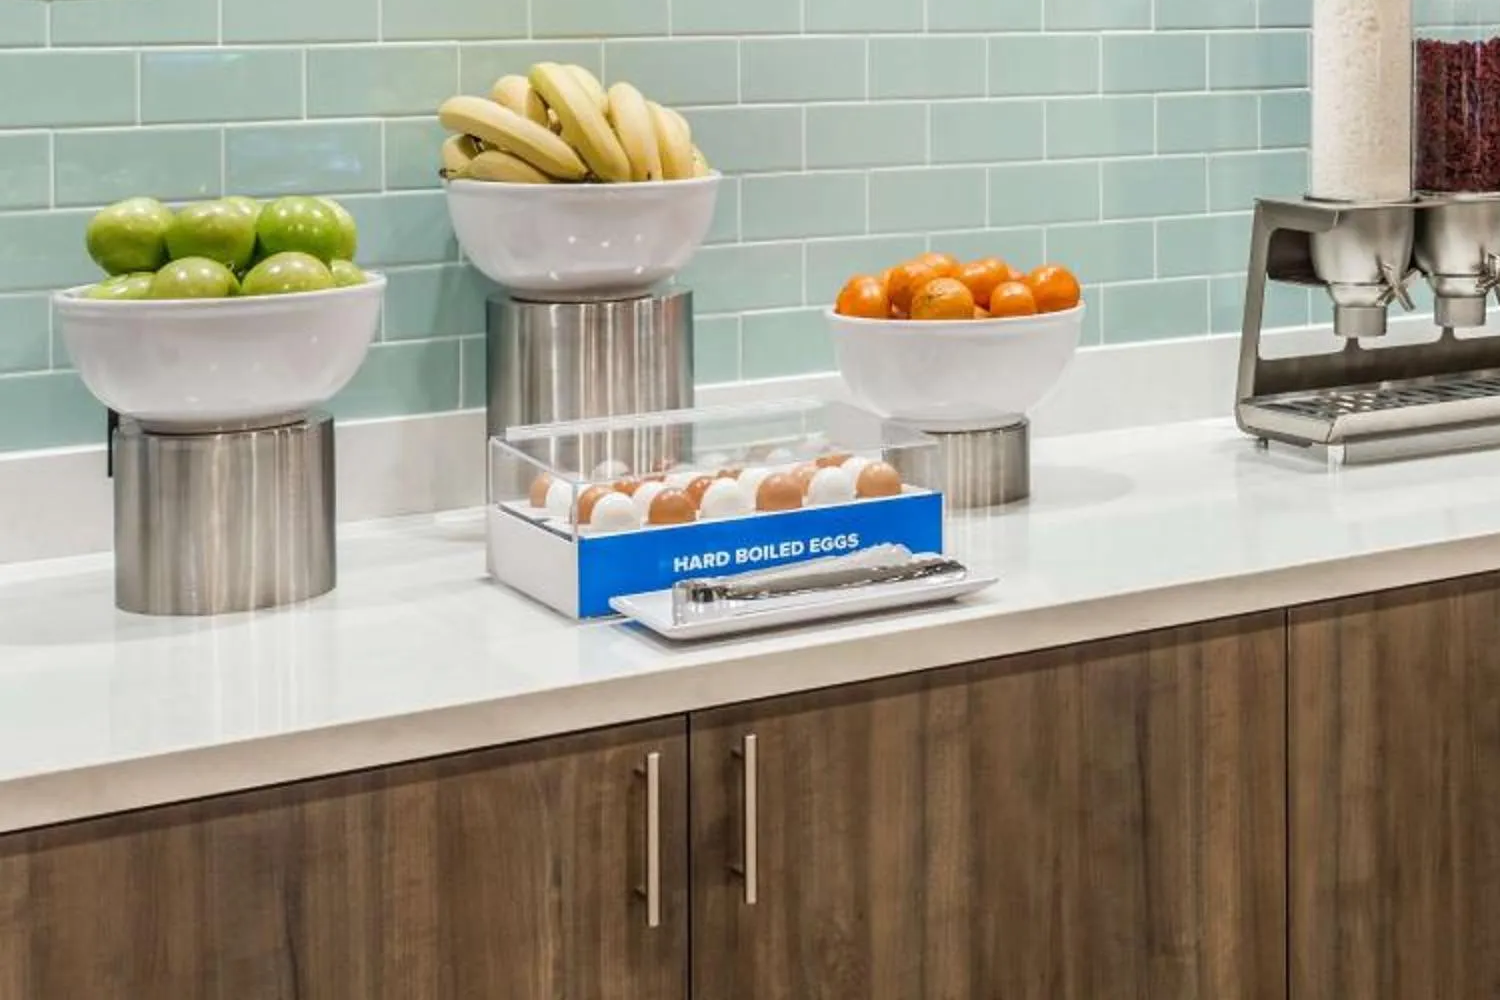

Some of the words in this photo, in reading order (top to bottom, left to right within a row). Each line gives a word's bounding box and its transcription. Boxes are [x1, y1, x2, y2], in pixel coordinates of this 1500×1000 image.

[673, 551, 731, 573] HARD
[735, 541, 805, 564] BOILED
[809, 533, 860, 553] EGGS
